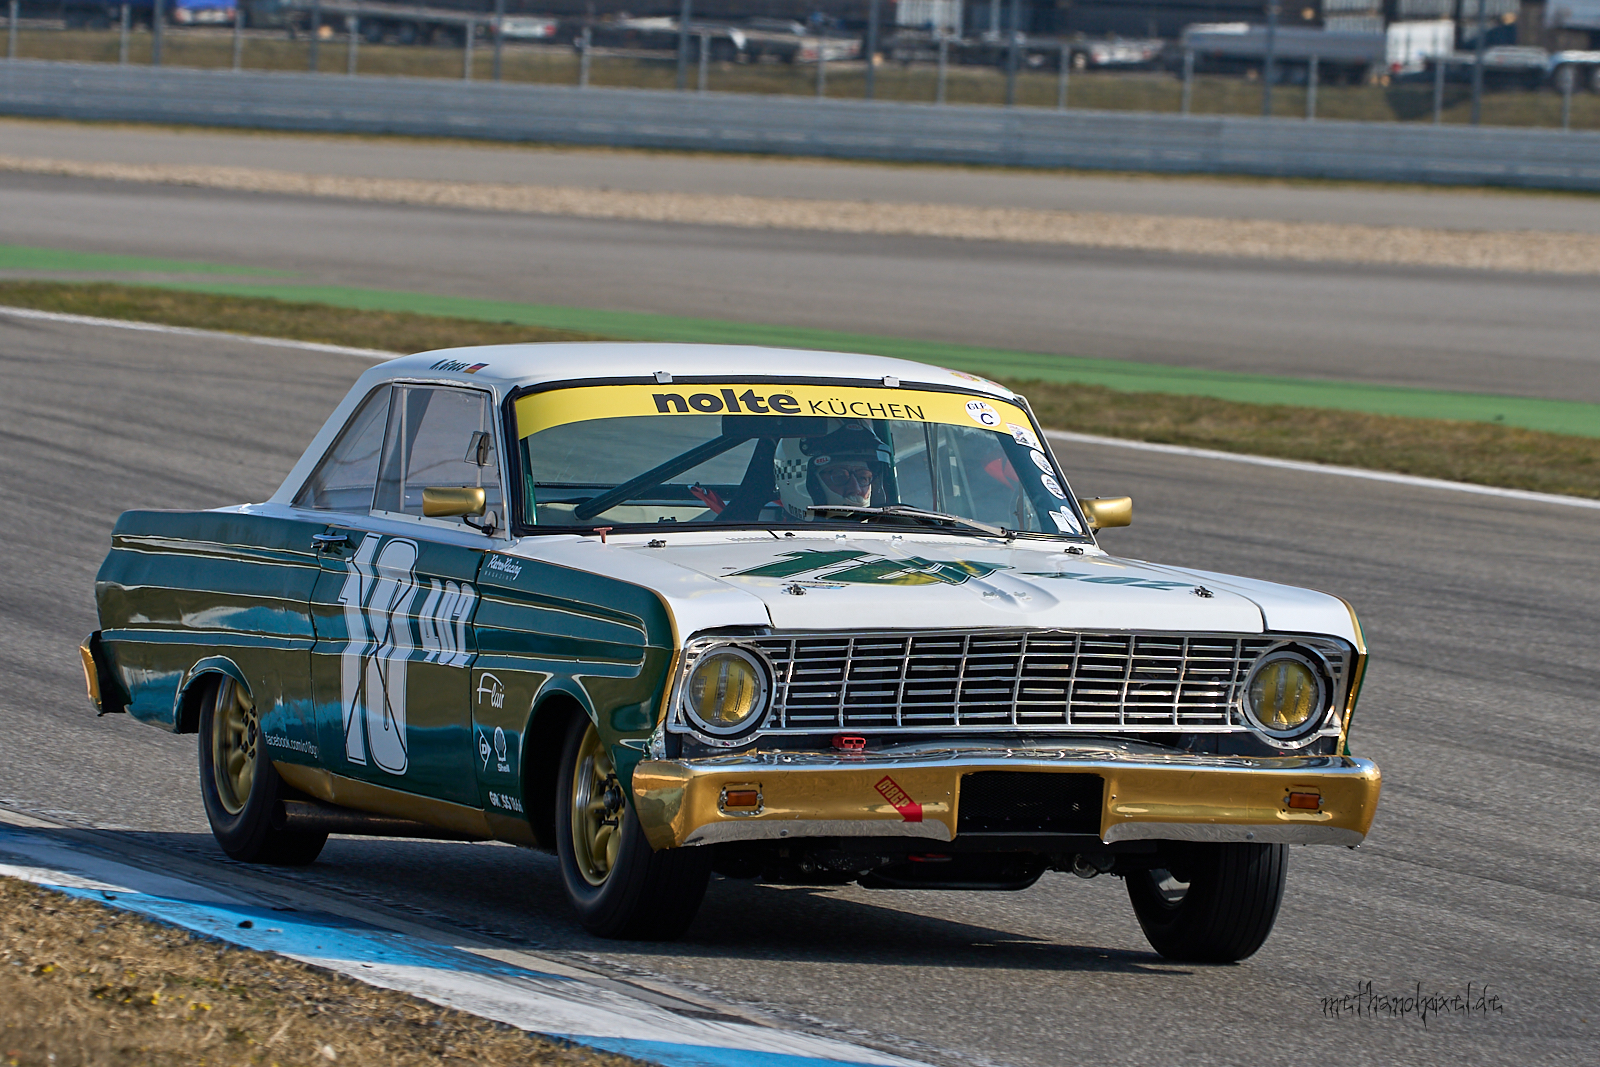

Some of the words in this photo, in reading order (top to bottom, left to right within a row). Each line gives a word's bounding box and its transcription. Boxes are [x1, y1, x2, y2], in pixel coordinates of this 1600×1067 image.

[651, 388, 801, 415] nolte
[808, 398, 926, 420] KÜCHEN
[981, 413, 994, 425] C
[815, 456, 829, 464] BELL
[476, 672, 505, 709] Flair
[497, 763, 511, 773] Shell
